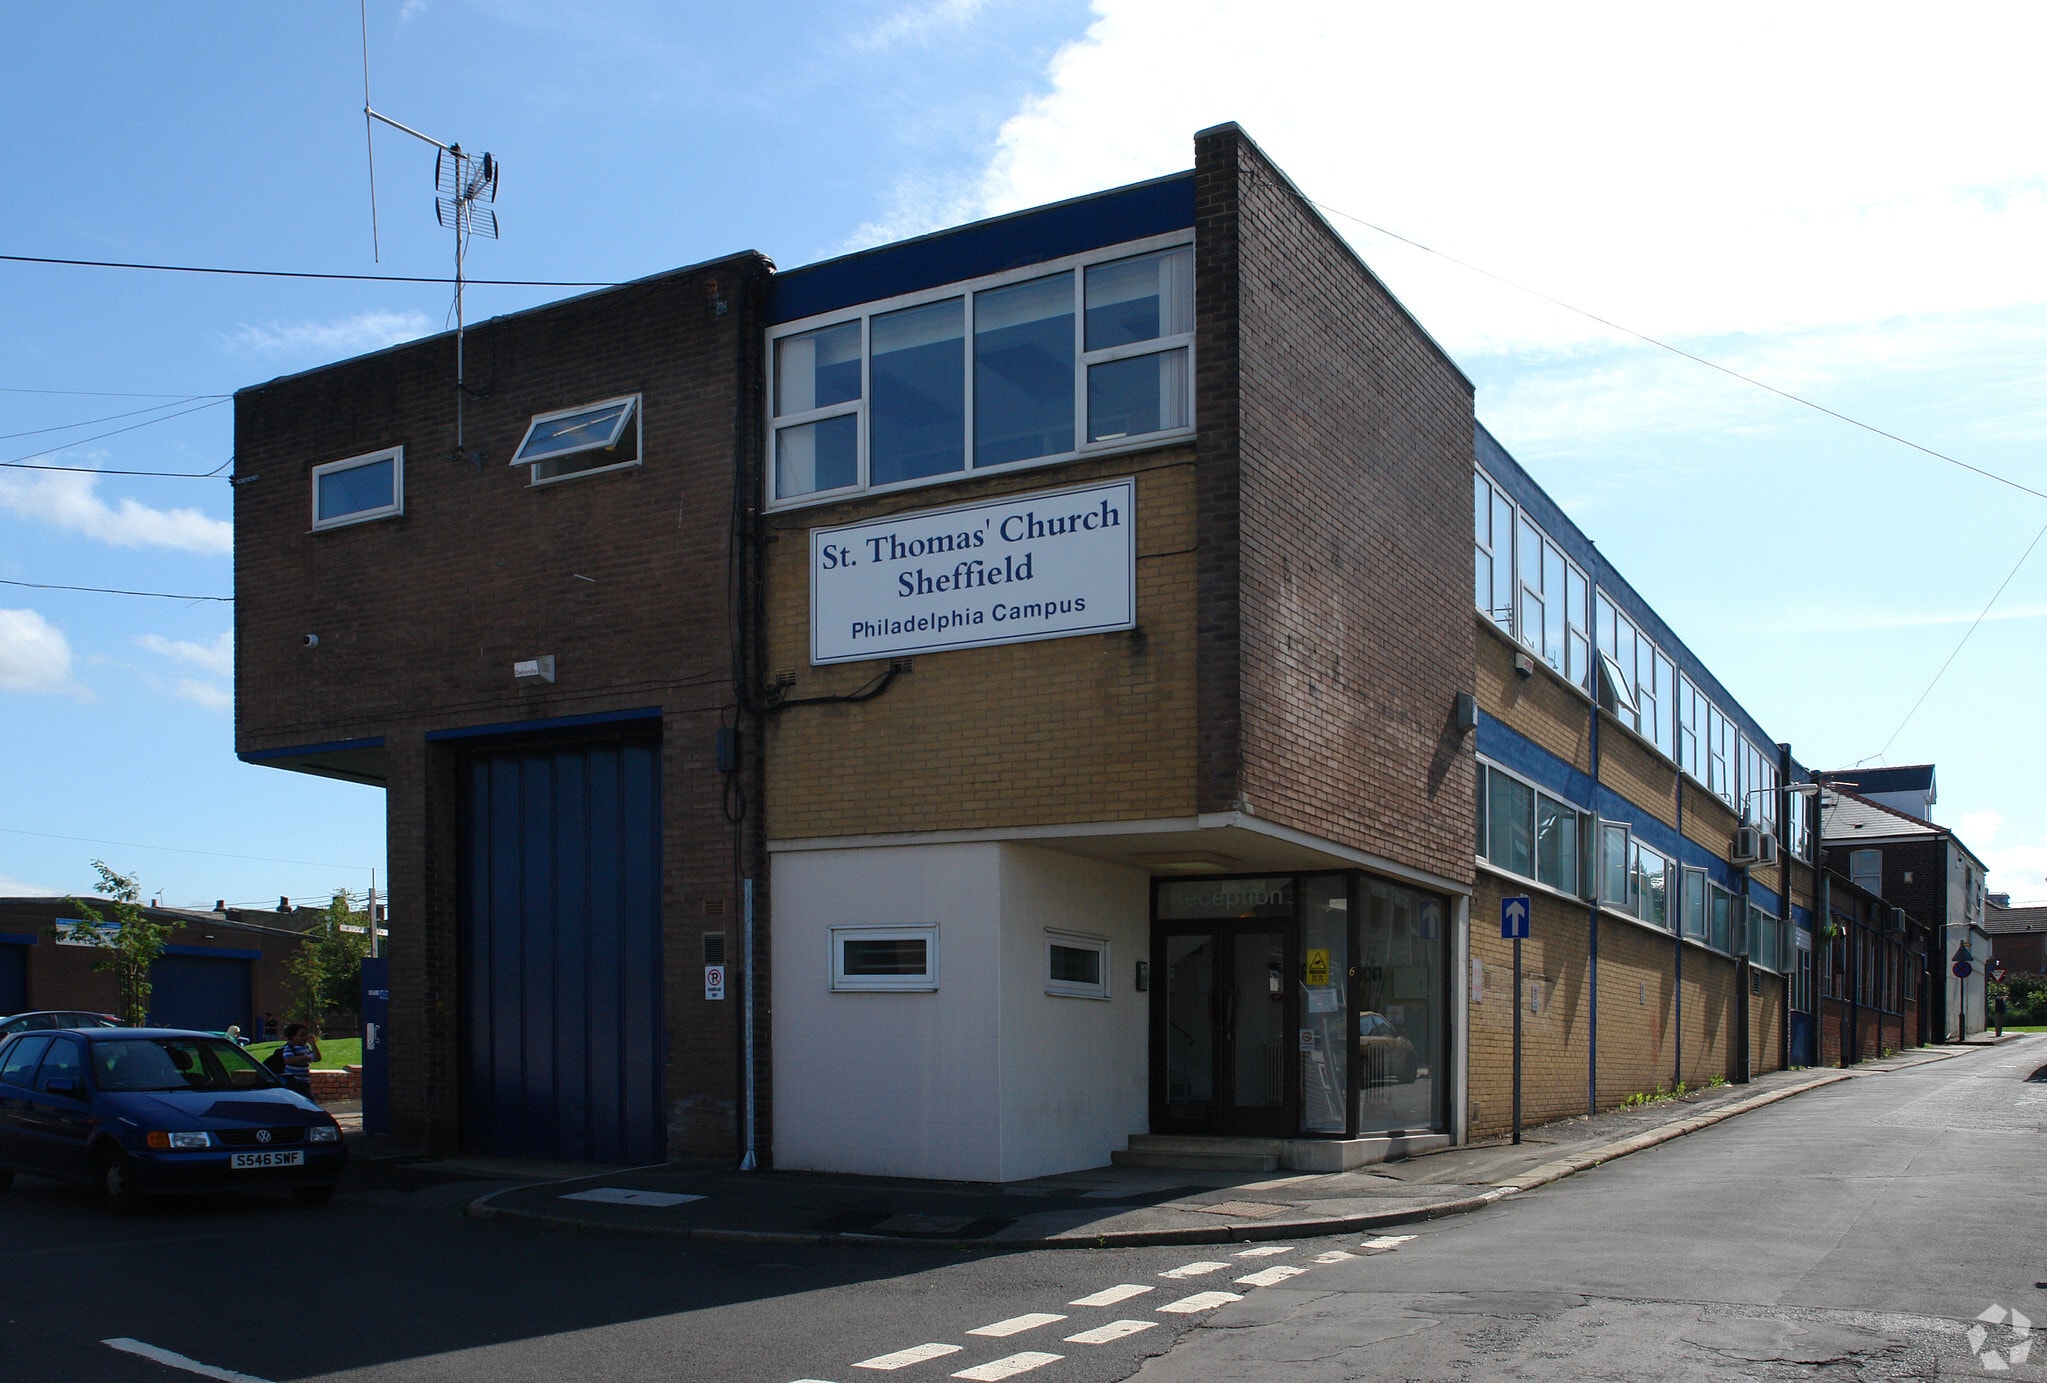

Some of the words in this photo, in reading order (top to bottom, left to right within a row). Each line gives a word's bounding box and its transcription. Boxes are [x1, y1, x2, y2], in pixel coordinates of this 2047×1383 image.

[822, 544, 857, 570] St.
[865, 518, 991, 564] Thomas'
[999, 499, 1121, 543] Church
[897, 552, 1034, 598] Sheffield
[852, 608, 984, 640] Philadelphia
[991, 596, 1086, 622] Campus
[1348, 966, 1356, 977] 6
[237, 1154, 271, 1166] S546
[275, 1152, 298, 1164] SWF
